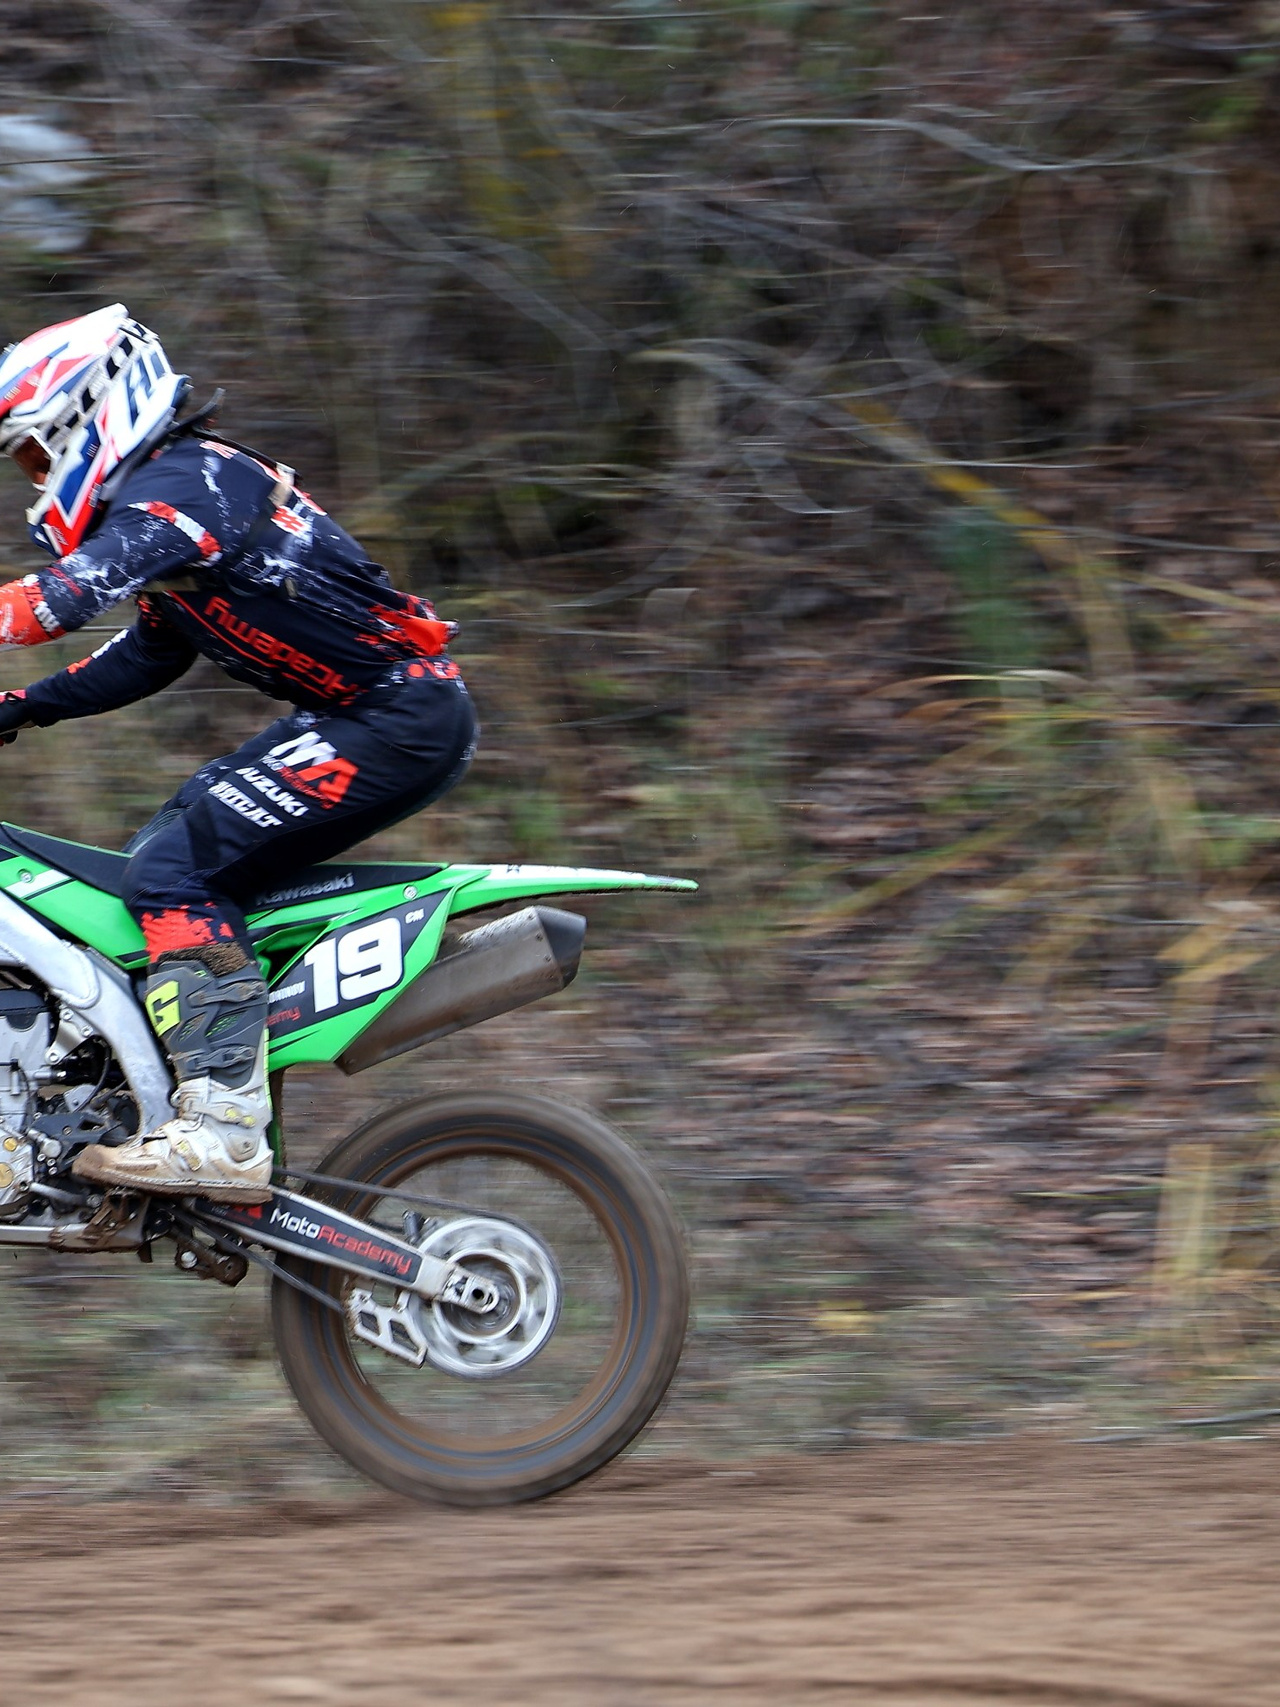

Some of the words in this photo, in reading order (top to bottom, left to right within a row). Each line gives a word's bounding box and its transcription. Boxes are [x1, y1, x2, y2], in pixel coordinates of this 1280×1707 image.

[254, 872, 355, 906] Kawasaki
[303, 916, 402, 1013] 19
[269, 1206, 413, 1275] MotoAcademy
